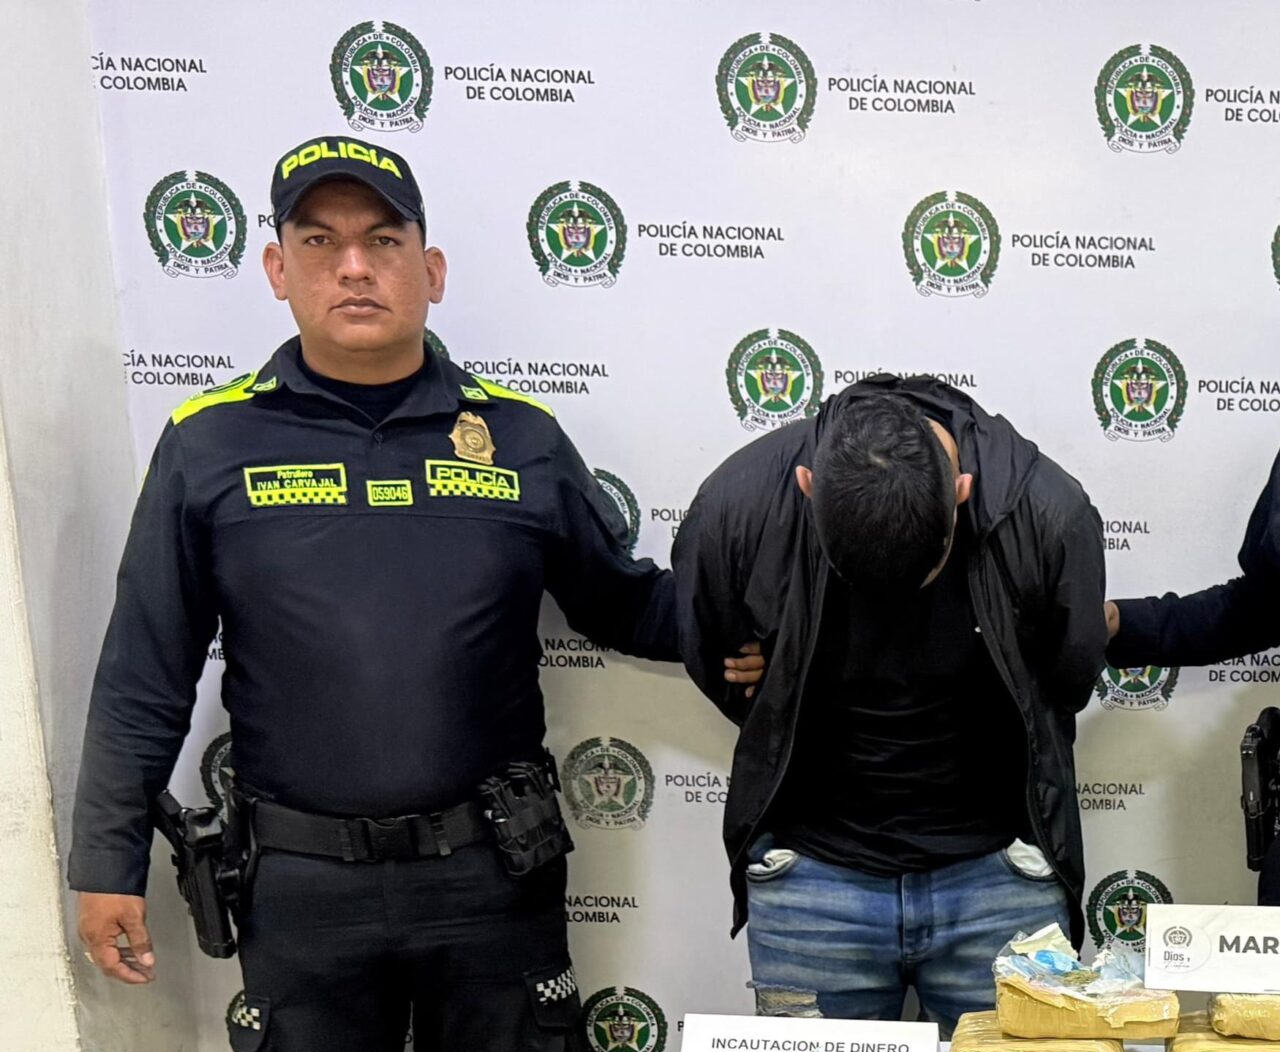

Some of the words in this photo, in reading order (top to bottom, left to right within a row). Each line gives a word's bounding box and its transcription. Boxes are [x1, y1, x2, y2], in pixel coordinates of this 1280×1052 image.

[391, 37, 419, 73] COLOMBIA
[121, 56, 207, 73] NACIONAL
[445, 63, 506, 81] POLICÍA
[511, 68, 595, 84] NACIONAL
[100, 76, 187, 91] COLOMBIA
[828, 78, 888, 93] POLICÍA
[894, 80, 975, 95] NACIONAL
[466, 86, 485, 100] DE
[490, 87, 575, 102] COLOMBIA
[1206, 86, 1264, 104] POLICÍA
[386, 96, 417, 118] NACIONAL
[849, 97, 867, 110] DE
[872, 98, 955, 113] COLOMBIA
[1225, 108, 1243, 121] DE
[204, 186, 233, 221] COLOMBIA
[638, 221, 698, 238] POLICÍA
[703, 226, 784, 240] NACIONAL
[1012, 231, 1071, 249] POLICÍA
[1076, 236, 1155, 251] NACIONAL
[201, 243, 232, 265] NACIONAL
[659, 243, 677, 256] DE
[682, 243, 764, 258] COLOMBIA
[1032, 253, 1049, 266] DE
[1054, 254, 1135, 268] COLOMBIA
[152, 354, 234, 368] NACIONAL
[463, 358, 523, 375] POLICÍA
[528, 363, 608, 377] NACIONAL
[132, 371, 215, 386] COLOMBIA
[1199, 377, 1255, 393] POLICÍA
[509, 380, 590, 394] COLOMBIA
[1217, 398, 1234, 411] DE
[257, 481, 280, 491] IVAN
[284, 478, 337, 489] CARVAJAL
[436, 467, 511, 488] POLICÍA
[372, 486, 408, 500] 059046
[539, 656, 605, 668] OLOMBIA
[1209, 671, 1226, 682] DE
[665, 772, 721, 788] POLICÍA
[685, 791, 702, 803] DE
[1081, 799, 1126, 810] OMBIA
[712, 1038, 819, 1051] INCAUTACION
[825, 1042, 845, 1052] DE
